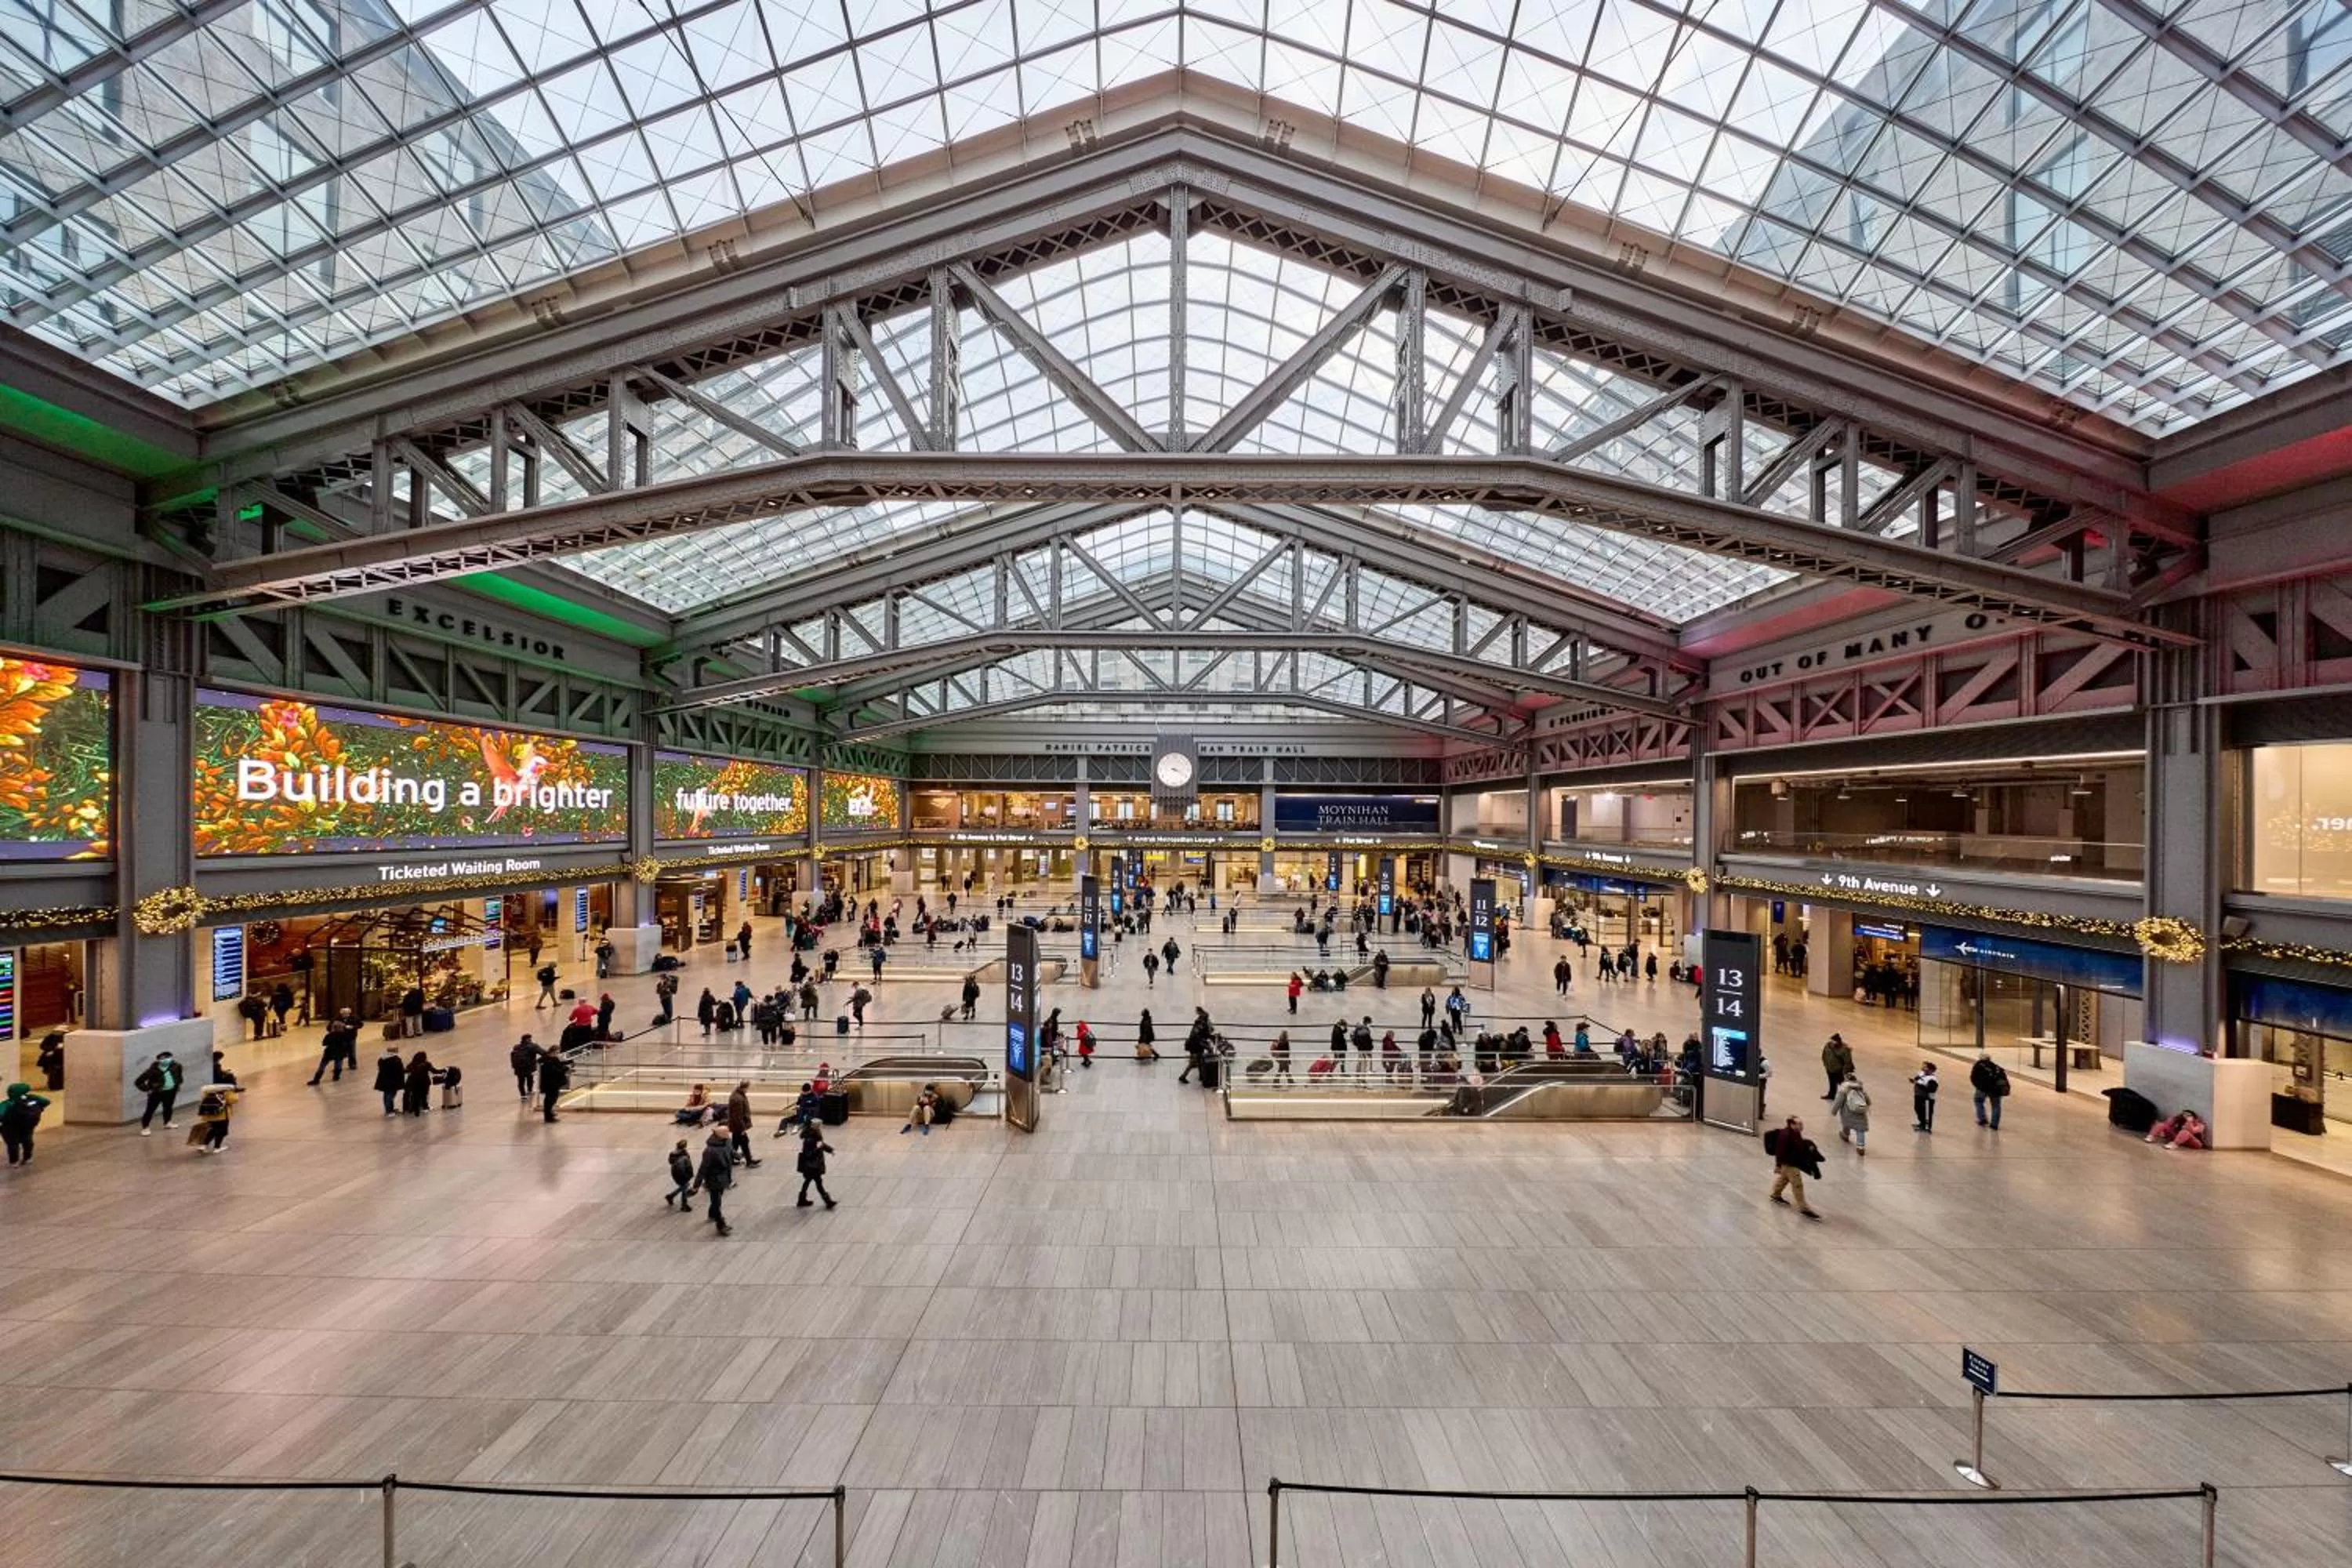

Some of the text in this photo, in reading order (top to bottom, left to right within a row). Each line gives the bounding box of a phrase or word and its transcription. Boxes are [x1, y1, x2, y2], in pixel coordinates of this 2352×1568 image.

[388, 598, 564, 660] EXCELSIOR
[1740, 662, 1784, 684] OUT
[1797, 652, 1828, 670] OF
[1844, 625, 1933, 659] MANY
[238, 759, 613, 814] Building a brighter
[676, 786, 793, 815] future together.
[1318, 805, 1388, 815] MOYNIHAN
[1317, 815, 1391, 826] TRAIN HALL
[379, 858, 541, 881] Ticketed Waiting Room
[1838, 875, 1918, 895] 9th Avenue
[1475, 899, 1486, 909] 11
[1475, 916, 1487, 927] 12
[1011, 964, 1024, 982] 13
[1718, 968, 1744, 988] 13
[1010, 992, 1023, 1012] 14
[1716, 997, 1744, 1018] 14
